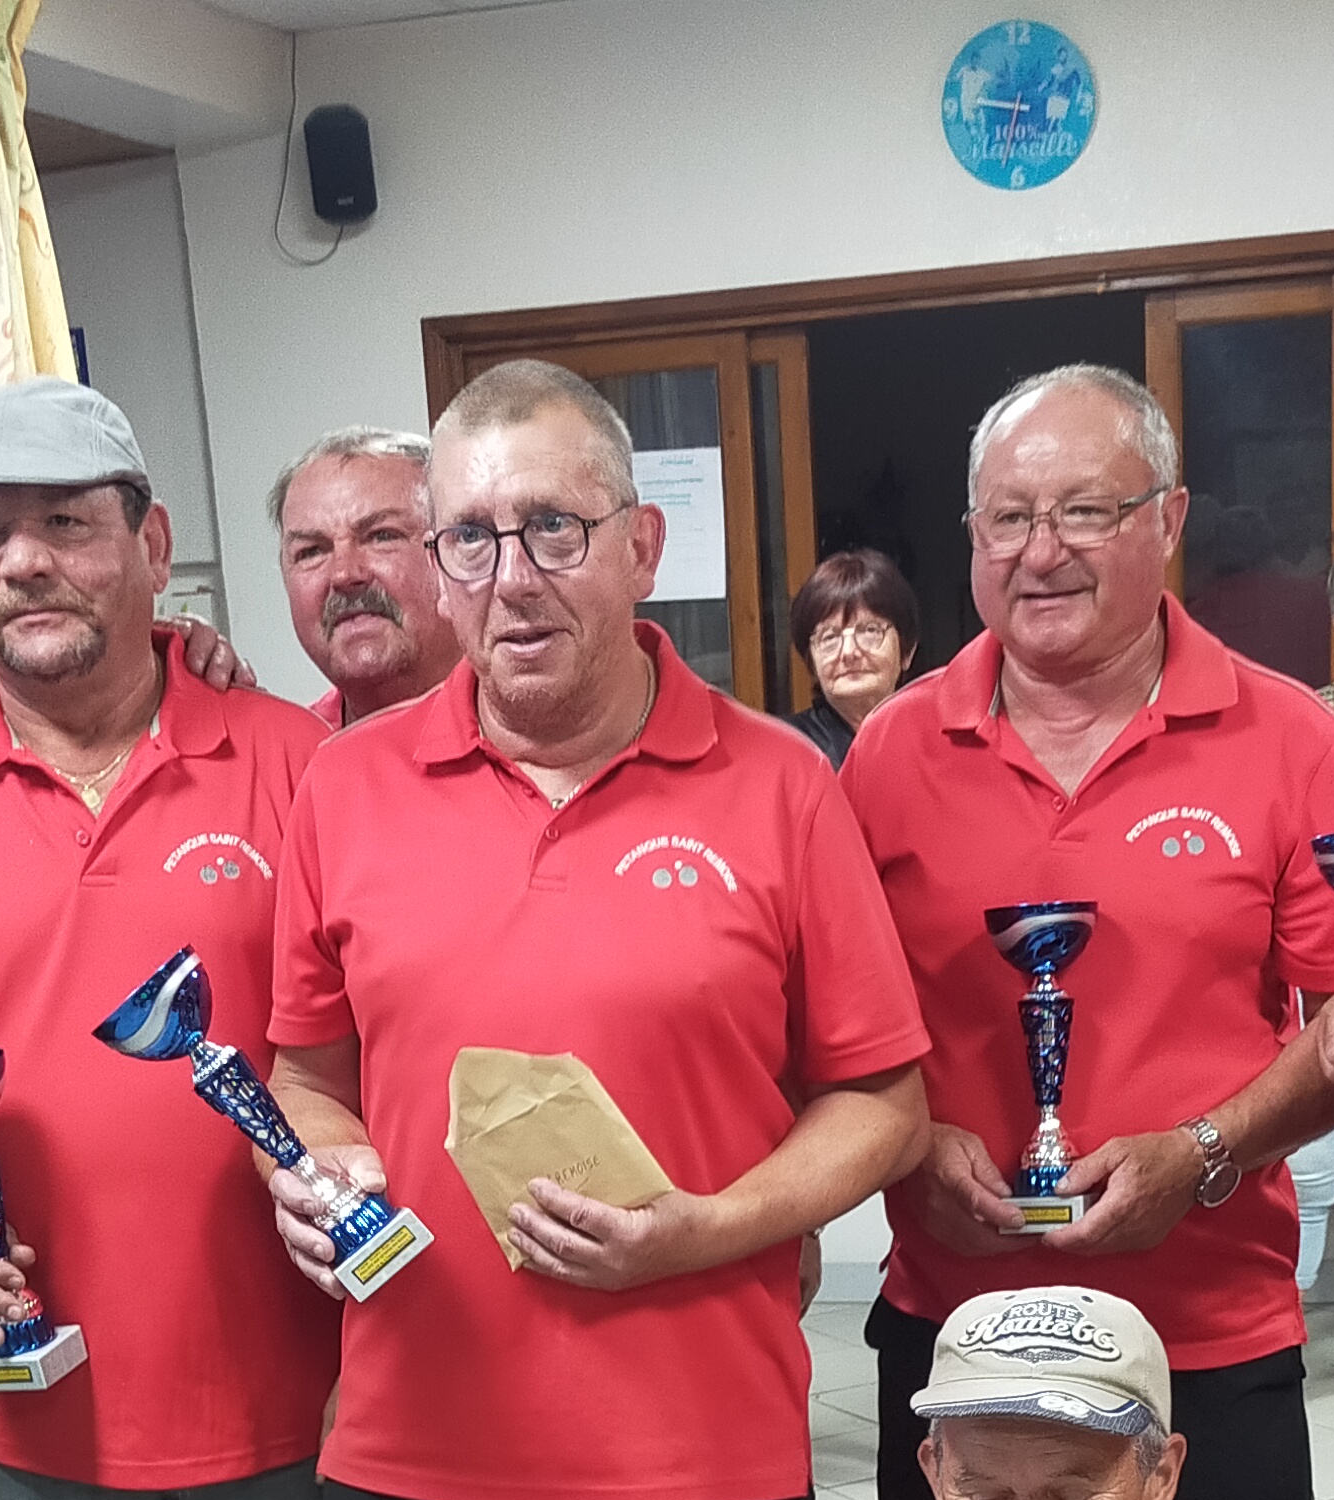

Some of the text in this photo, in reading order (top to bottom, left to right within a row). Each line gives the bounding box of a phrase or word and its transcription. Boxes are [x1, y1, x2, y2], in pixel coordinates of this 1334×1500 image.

[1005, 22, 1031, 45] 12
[1010, 166, 1027, 188] 6
[1125, 806, 1243, 860] PETANQUE SAINT REMOISE
[163, 832, 274, 880] PETANQUE SAINT REMOISE
[615, 835, 738, 893] PETANQUE SAINT REMOISE
[1009, 1301, 1078, 1321] ROUTE
